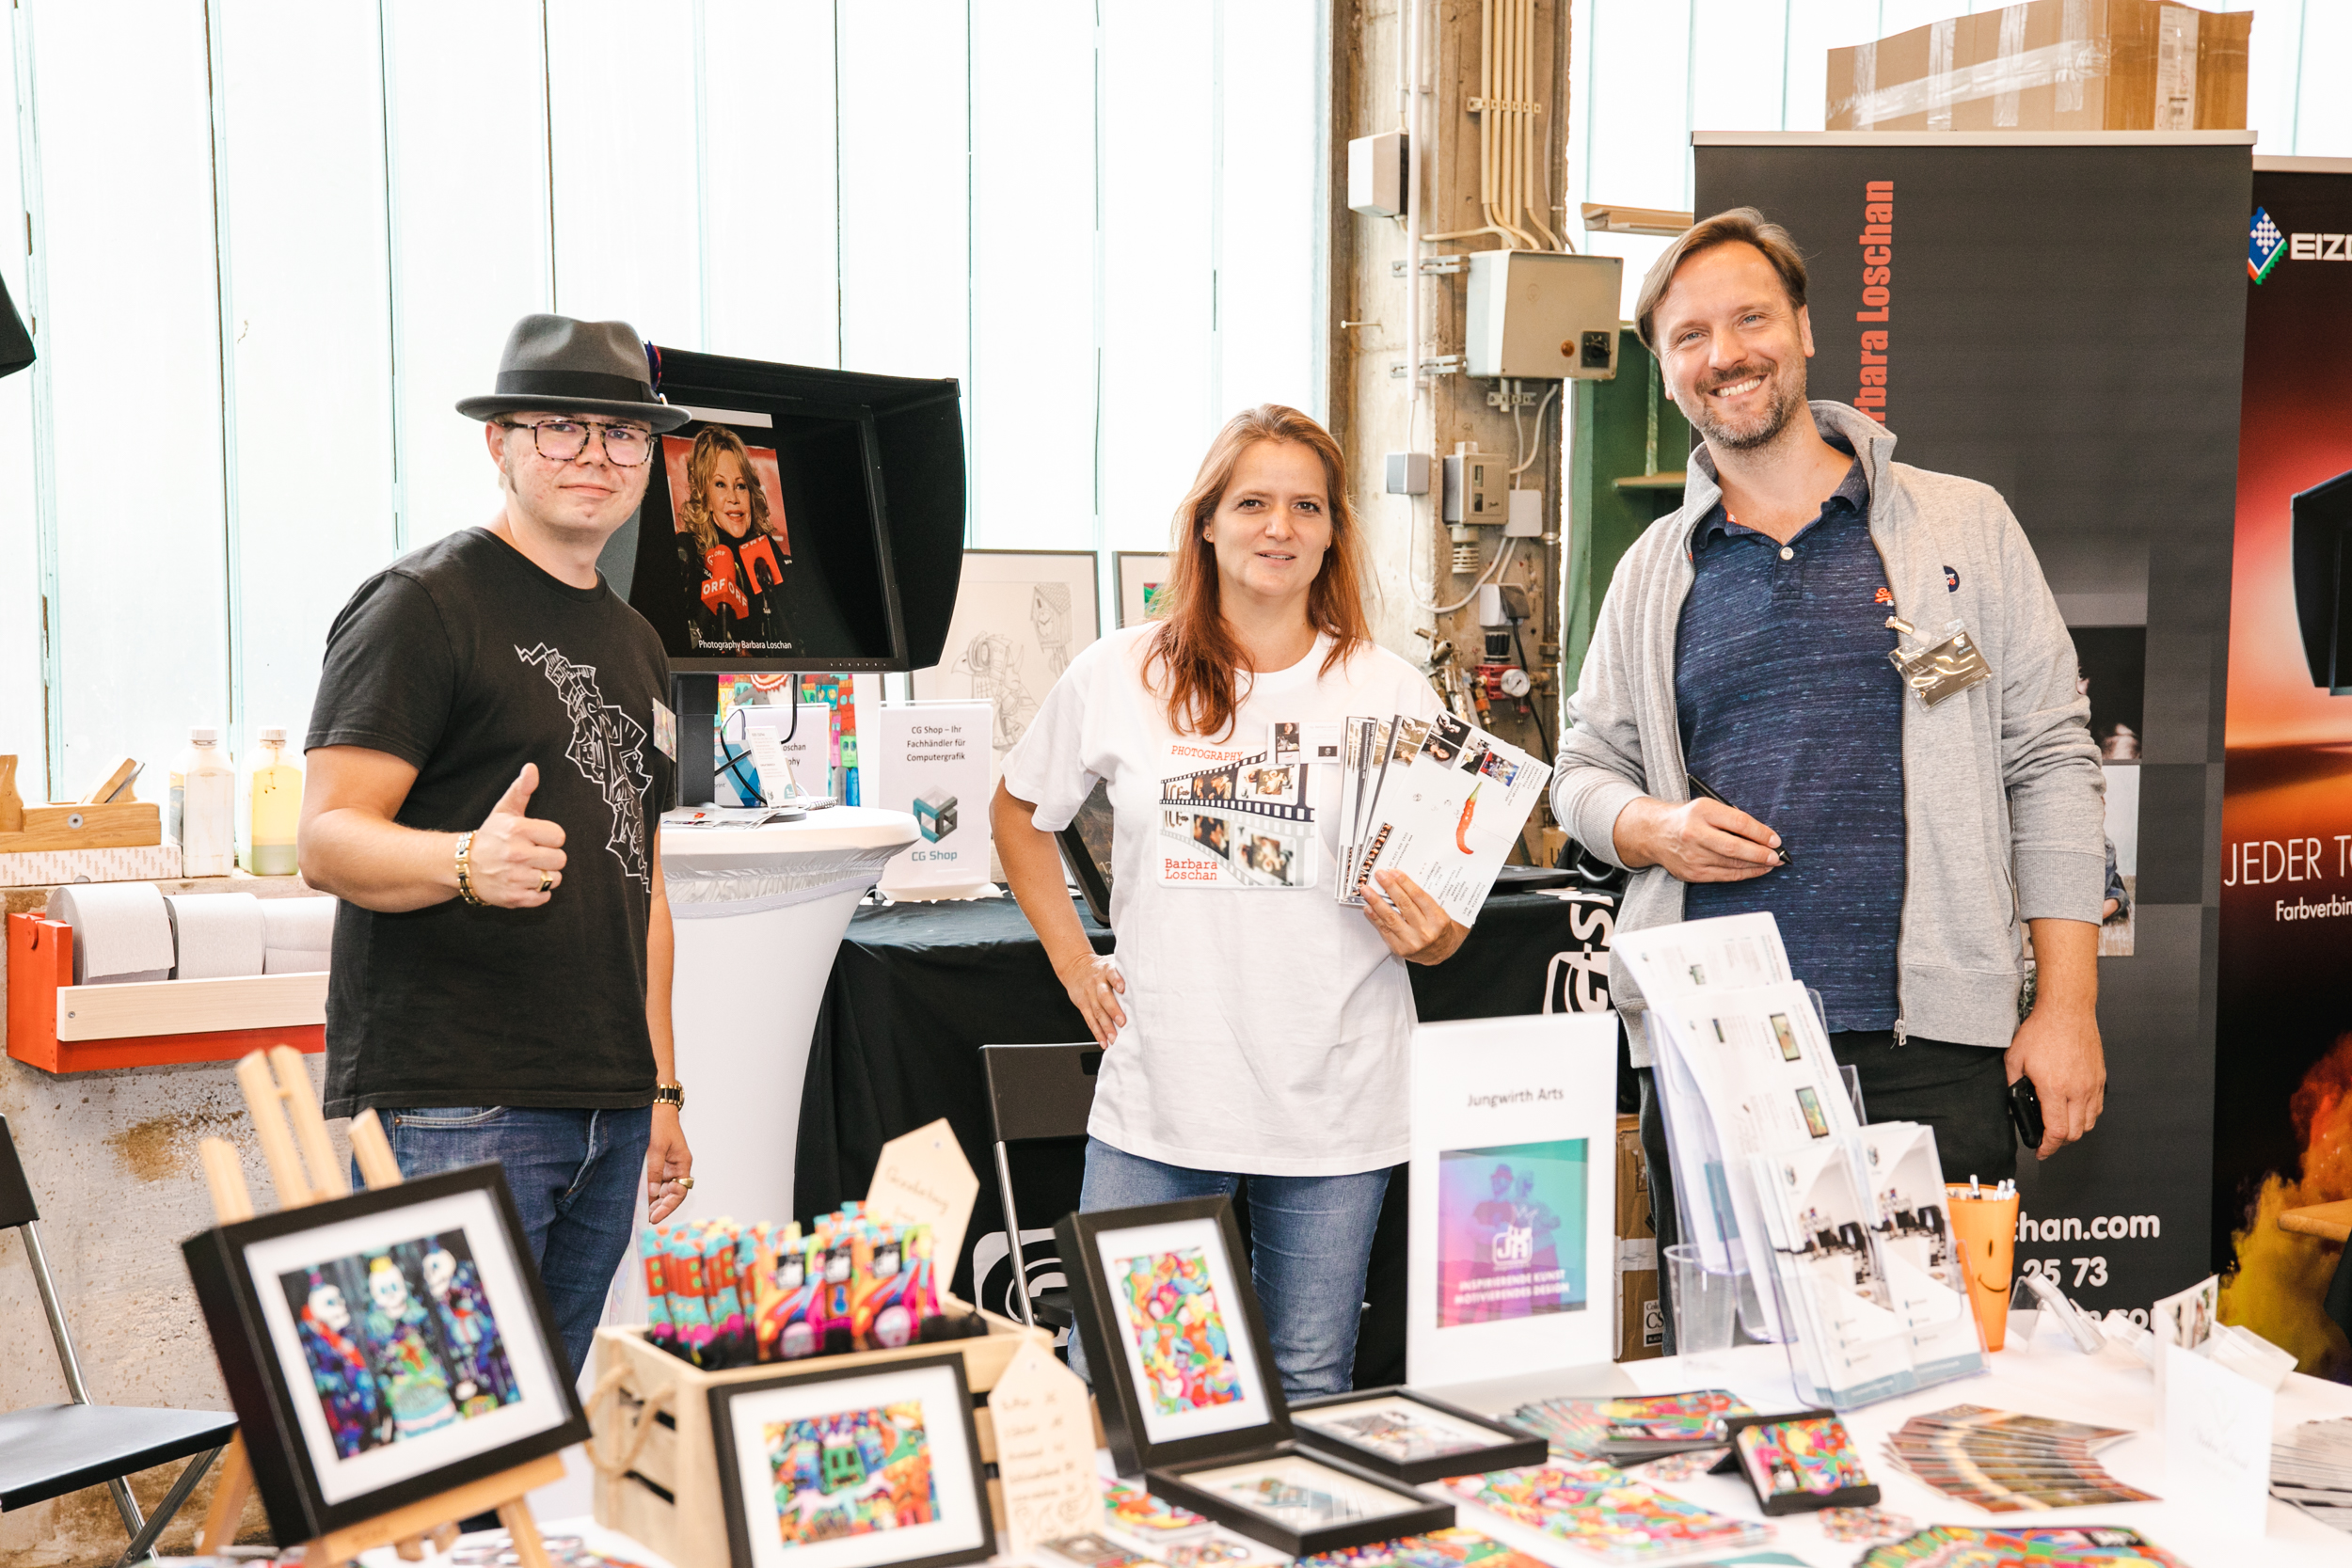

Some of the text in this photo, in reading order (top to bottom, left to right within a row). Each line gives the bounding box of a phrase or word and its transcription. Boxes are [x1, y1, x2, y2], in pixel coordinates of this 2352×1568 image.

[1856, 181, 1894, 322] Loschan
[703, 578, 726, 595] ORF
[727, 581, 748, 607] ORF
[698, 640, 792, 651] Photography Barbara Loschan
[911, 725, 922, 734] CG
[924, 725, 944, 735] Shop
[951, 725, 961, 734] Ihr
[782, 743, 806, 752] oschan
[906, 738, 966, 748] Fachhändler für
[906, 752, 966, 763] Computergrafik
[1171, 745, 1244, 761] PHOTOGRAPHY
[912, 851, 958, 862] CG Shop
[2223, 837, 2322, 886] JEDER
[1165, 859, 1217, 869] Barbara
[1165, 869, 1217, 880] Loschan
[2276, 894, 2352, 922] Farbverbin
[1468, 1087, 1565, 1108] Jungwirth Arts
[1534, 1270, 1565, 1285] KUNST
[2072, 1256, 2108, 1288] 73
[1534, 1283, 1570, 1297] DESIGN
